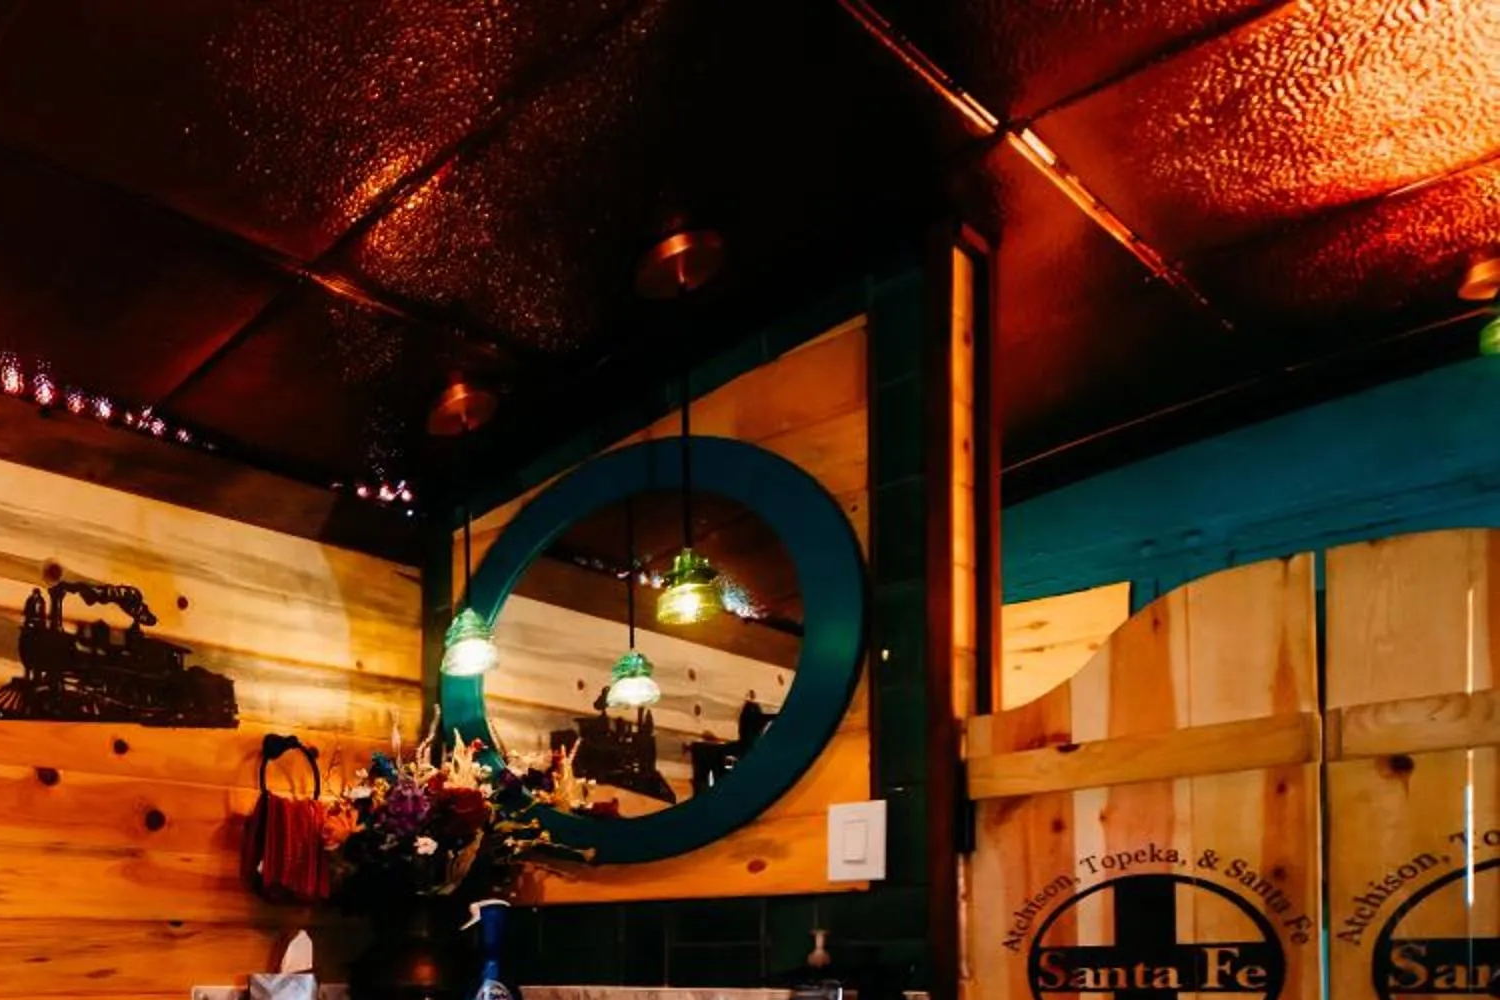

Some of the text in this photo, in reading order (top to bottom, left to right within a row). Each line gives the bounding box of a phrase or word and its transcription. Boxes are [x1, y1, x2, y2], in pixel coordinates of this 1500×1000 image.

[1002, 842, 1312, 952] Atchison, Topeka, & Santa Fe
[1337, 852, 1452, 947] Atchison,
[1037, 947, 1268, 990] Santa Fe
